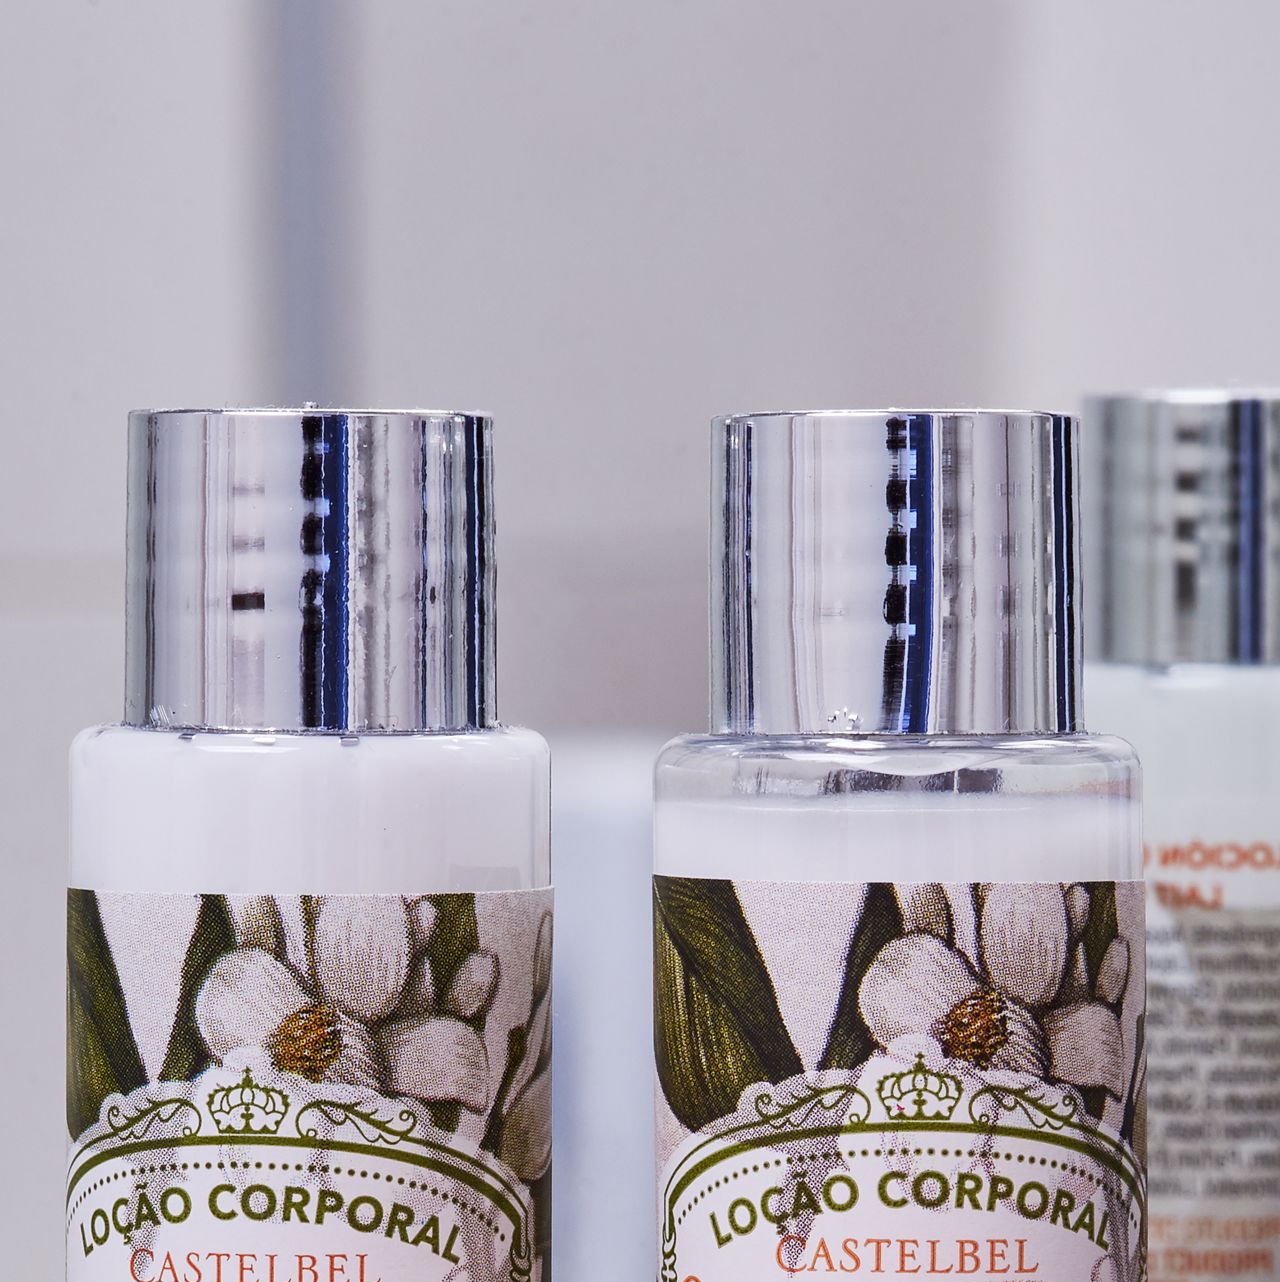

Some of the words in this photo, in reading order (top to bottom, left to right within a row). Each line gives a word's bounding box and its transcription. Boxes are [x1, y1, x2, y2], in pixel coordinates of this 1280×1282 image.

[80, 1183, 193, 1257] LOÇÃO
[208, 1183, 462, 1265] CORPORAL
[709, 1168, 860, 1249] LOÇÃO
[877, 1169, 1112, 1252] CORPORAL
[775, 1235, 1041, 1275] CASTELBEL
